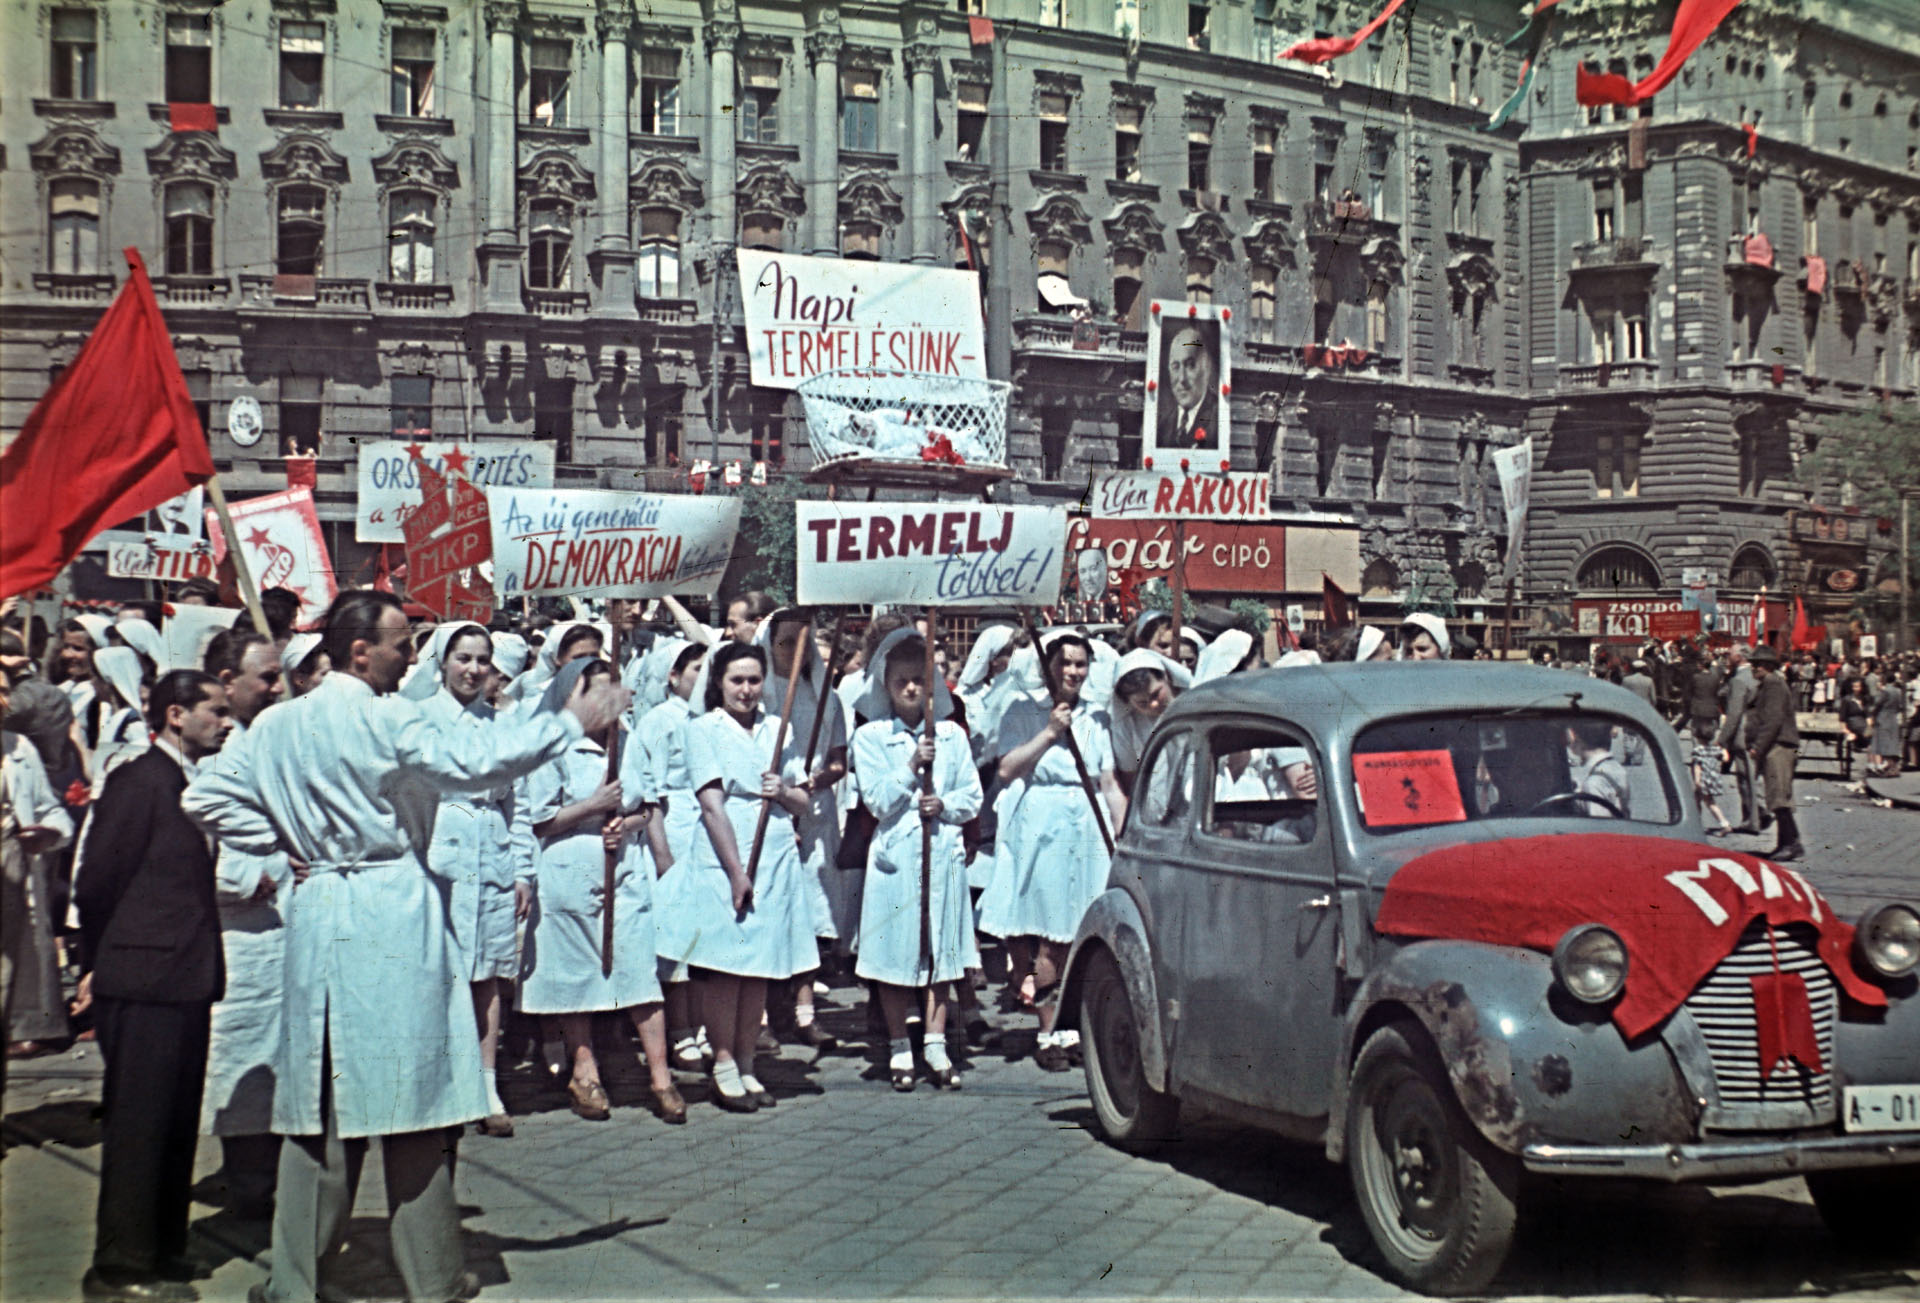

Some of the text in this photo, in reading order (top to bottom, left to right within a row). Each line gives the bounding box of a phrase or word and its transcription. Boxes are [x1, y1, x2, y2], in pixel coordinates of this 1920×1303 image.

[754, 260, 858, 333] Napi
[502, 496, 534, 534] Az
[542, 497, 569, 534] új
[1153, 473, 1267, 515] RÁKOSI!
[419, 533, 480, 579] MKP
[807, 511, 1015, 563] TERMELJ
[155, 550, 219, 579] TILD
[504, 572, 517, 591] a
[523, 534, 682, 592] DEMOKRÁCIA
[934, 541, 1054, 598] többet!
